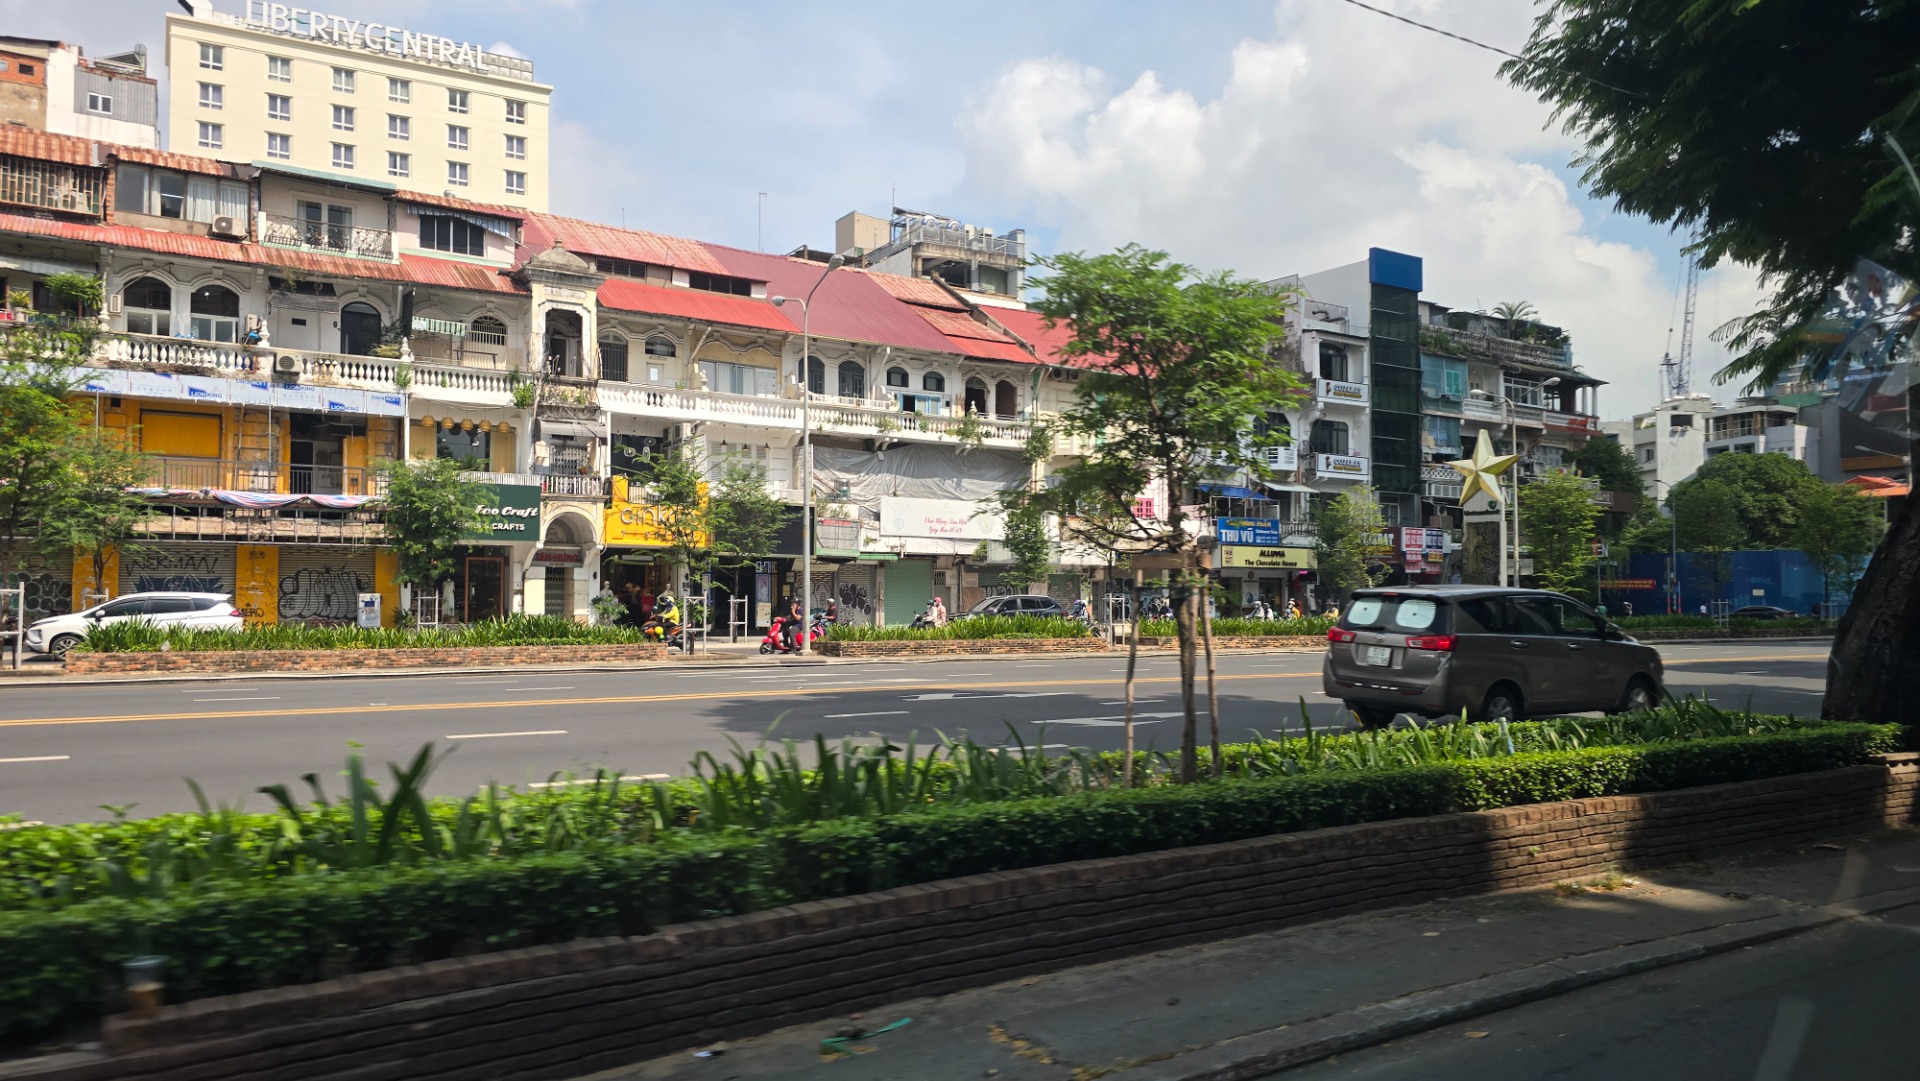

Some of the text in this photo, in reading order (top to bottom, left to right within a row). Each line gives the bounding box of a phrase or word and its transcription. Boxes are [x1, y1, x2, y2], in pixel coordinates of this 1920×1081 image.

[245, 0, 490, 71] LIBERTY CENTRAL
[501, 506, 538, 518] Craft
[493, 522, 525, 531] CRAFTS
[1220, 529, 1239, 542] THU
[1241, 527, 1254, 543] VŨ
[1255, 559, 1281, 567] Chocolate
